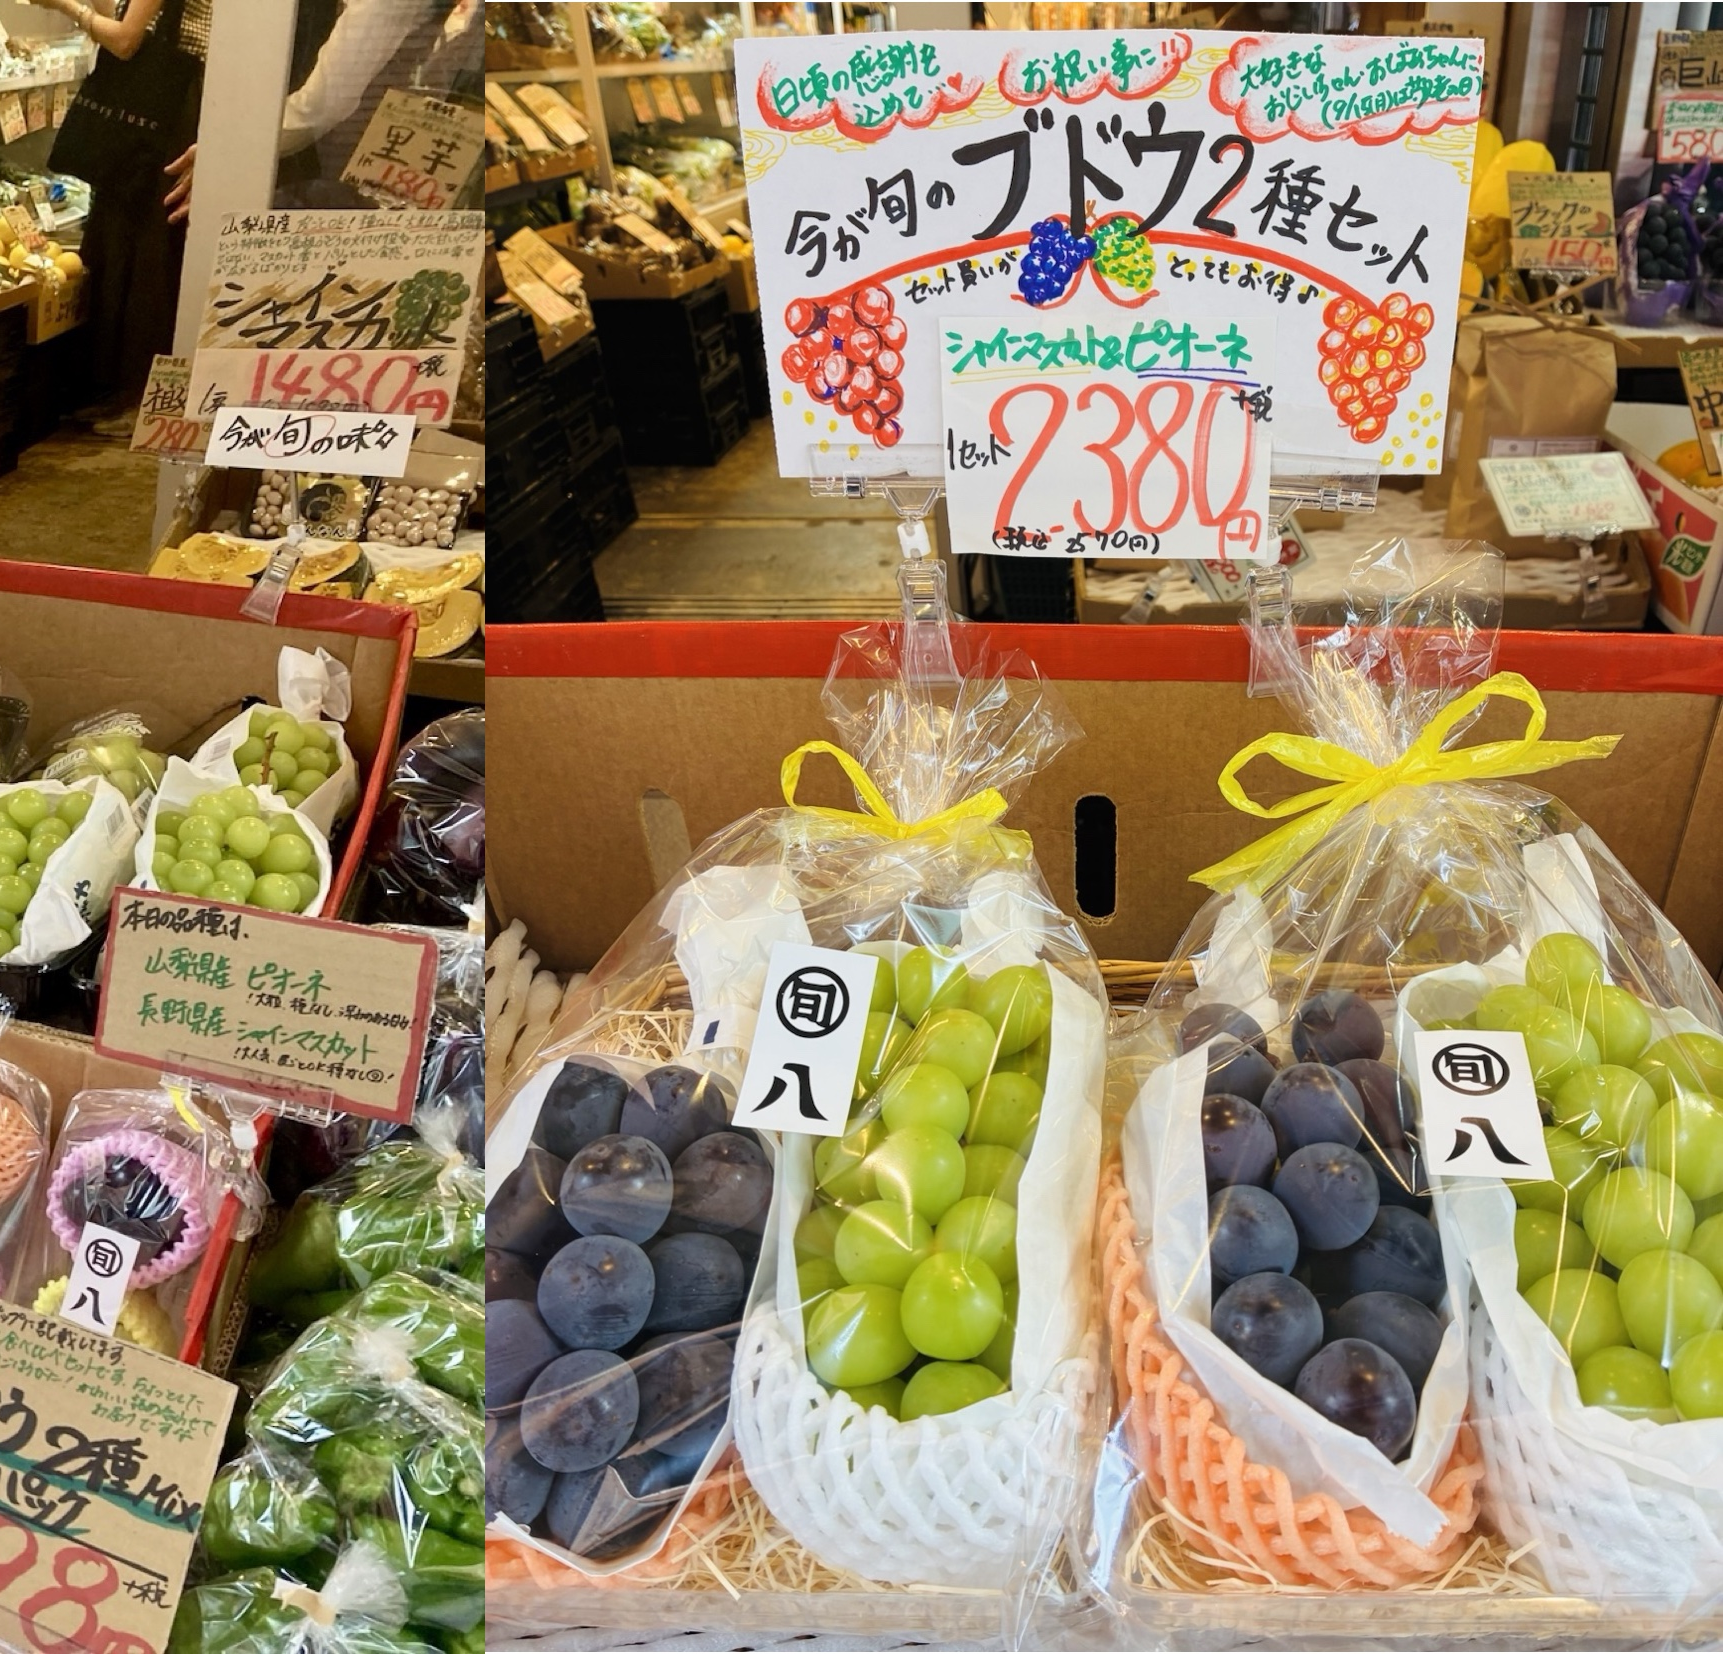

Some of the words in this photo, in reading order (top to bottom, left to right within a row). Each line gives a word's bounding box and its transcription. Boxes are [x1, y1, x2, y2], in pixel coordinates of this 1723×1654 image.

[772, 43, 942, 119] 日頃の感謝を
[1240, 44, 1326, 97] 大好きな
[213, 270, 399, 329] シャイン
[947, 429, 1012, 471] 1セット
[144, 947, 233, 990] 山梨県産
[247, 962, 332, 1001] ピオーネ
[138, 993, 233, 1037] 長野県産
[236, 1019, 378, 1065] シャインマスカット
[123, 1578, 173, 1610] +税
